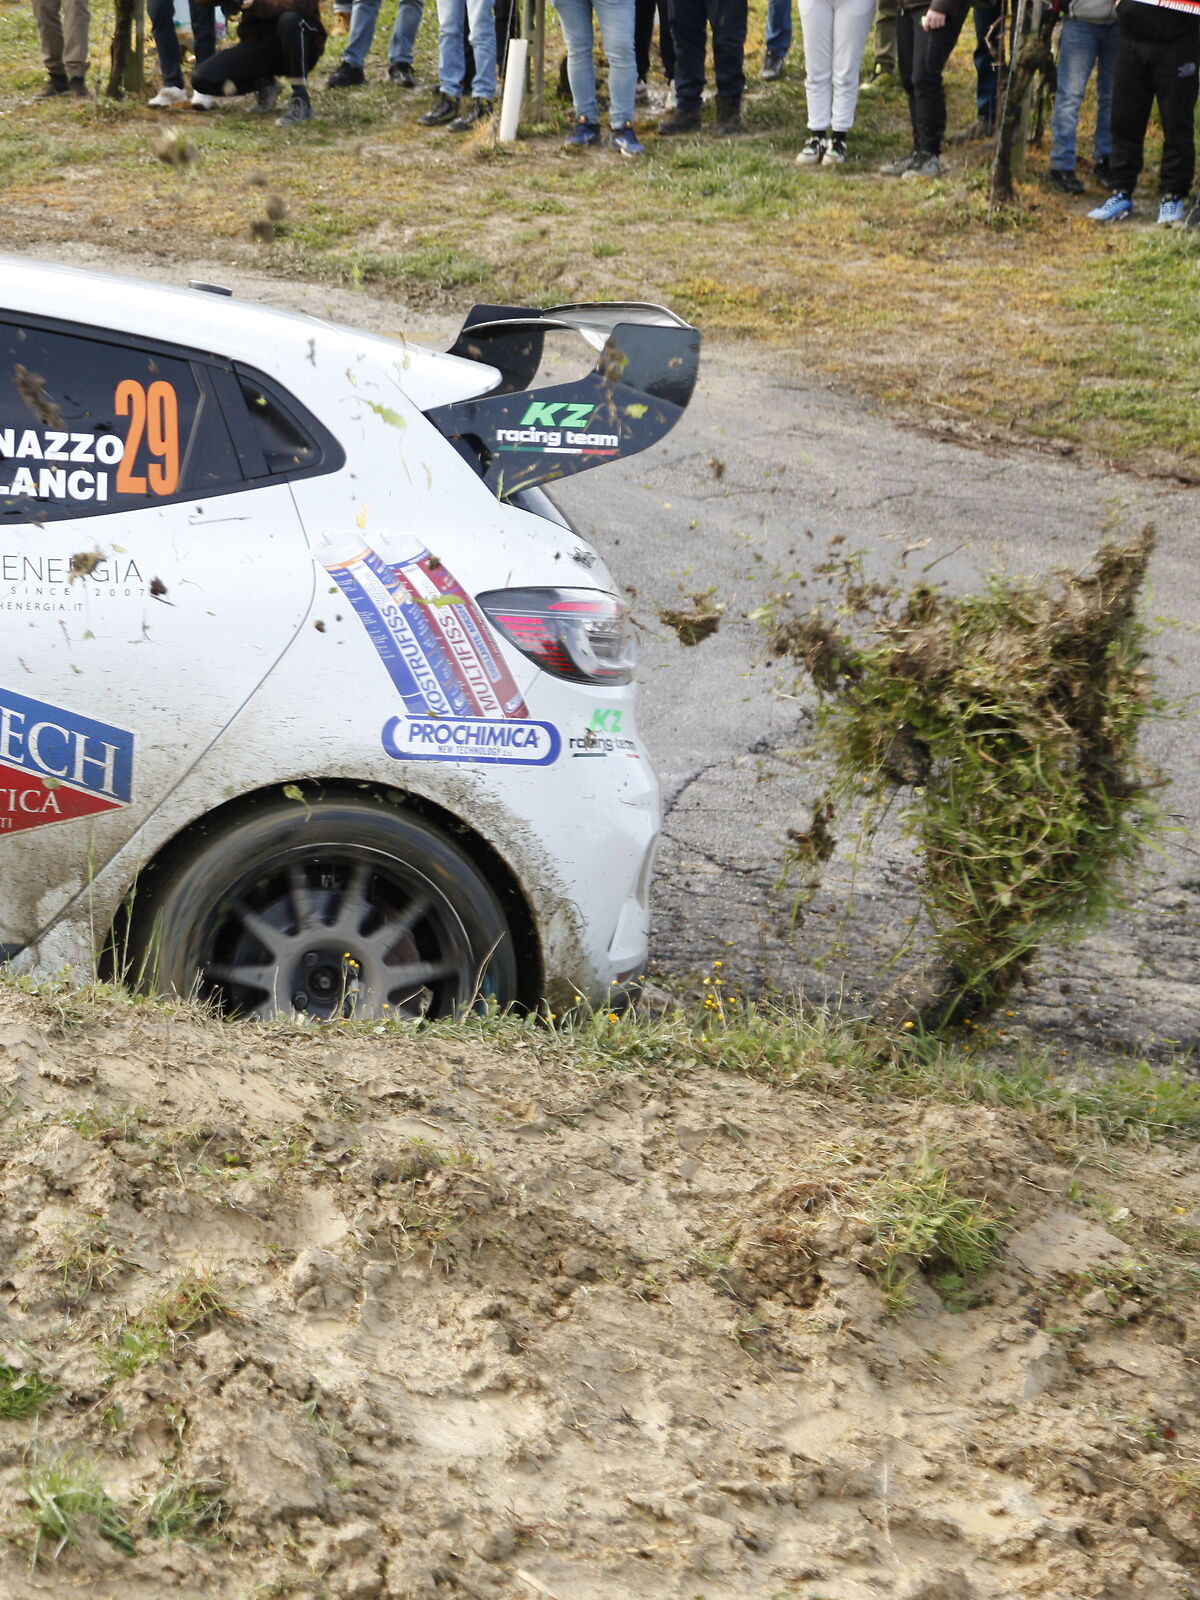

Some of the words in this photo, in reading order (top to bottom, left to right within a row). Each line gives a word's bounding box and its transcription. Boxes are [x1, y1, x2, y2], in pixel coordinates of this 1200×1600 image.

[519, 401, 595, 428] KZ
[114, 379, 179, 496] 29
[496, 427, 562, 446] racing
[566, 430, 619, 447] team
[10, 587, 71, 596] SINCE
[95, 588, 145, 597] 2007
[382, 604, 450, 715] KOSTRUFISS
[439, 614, 499, 711] MULTIFISS
[588, 708, 625, 733] KZ
[408, 722, 539, 749] PROCHIMICA
[569, 737, 613, 752] raing
